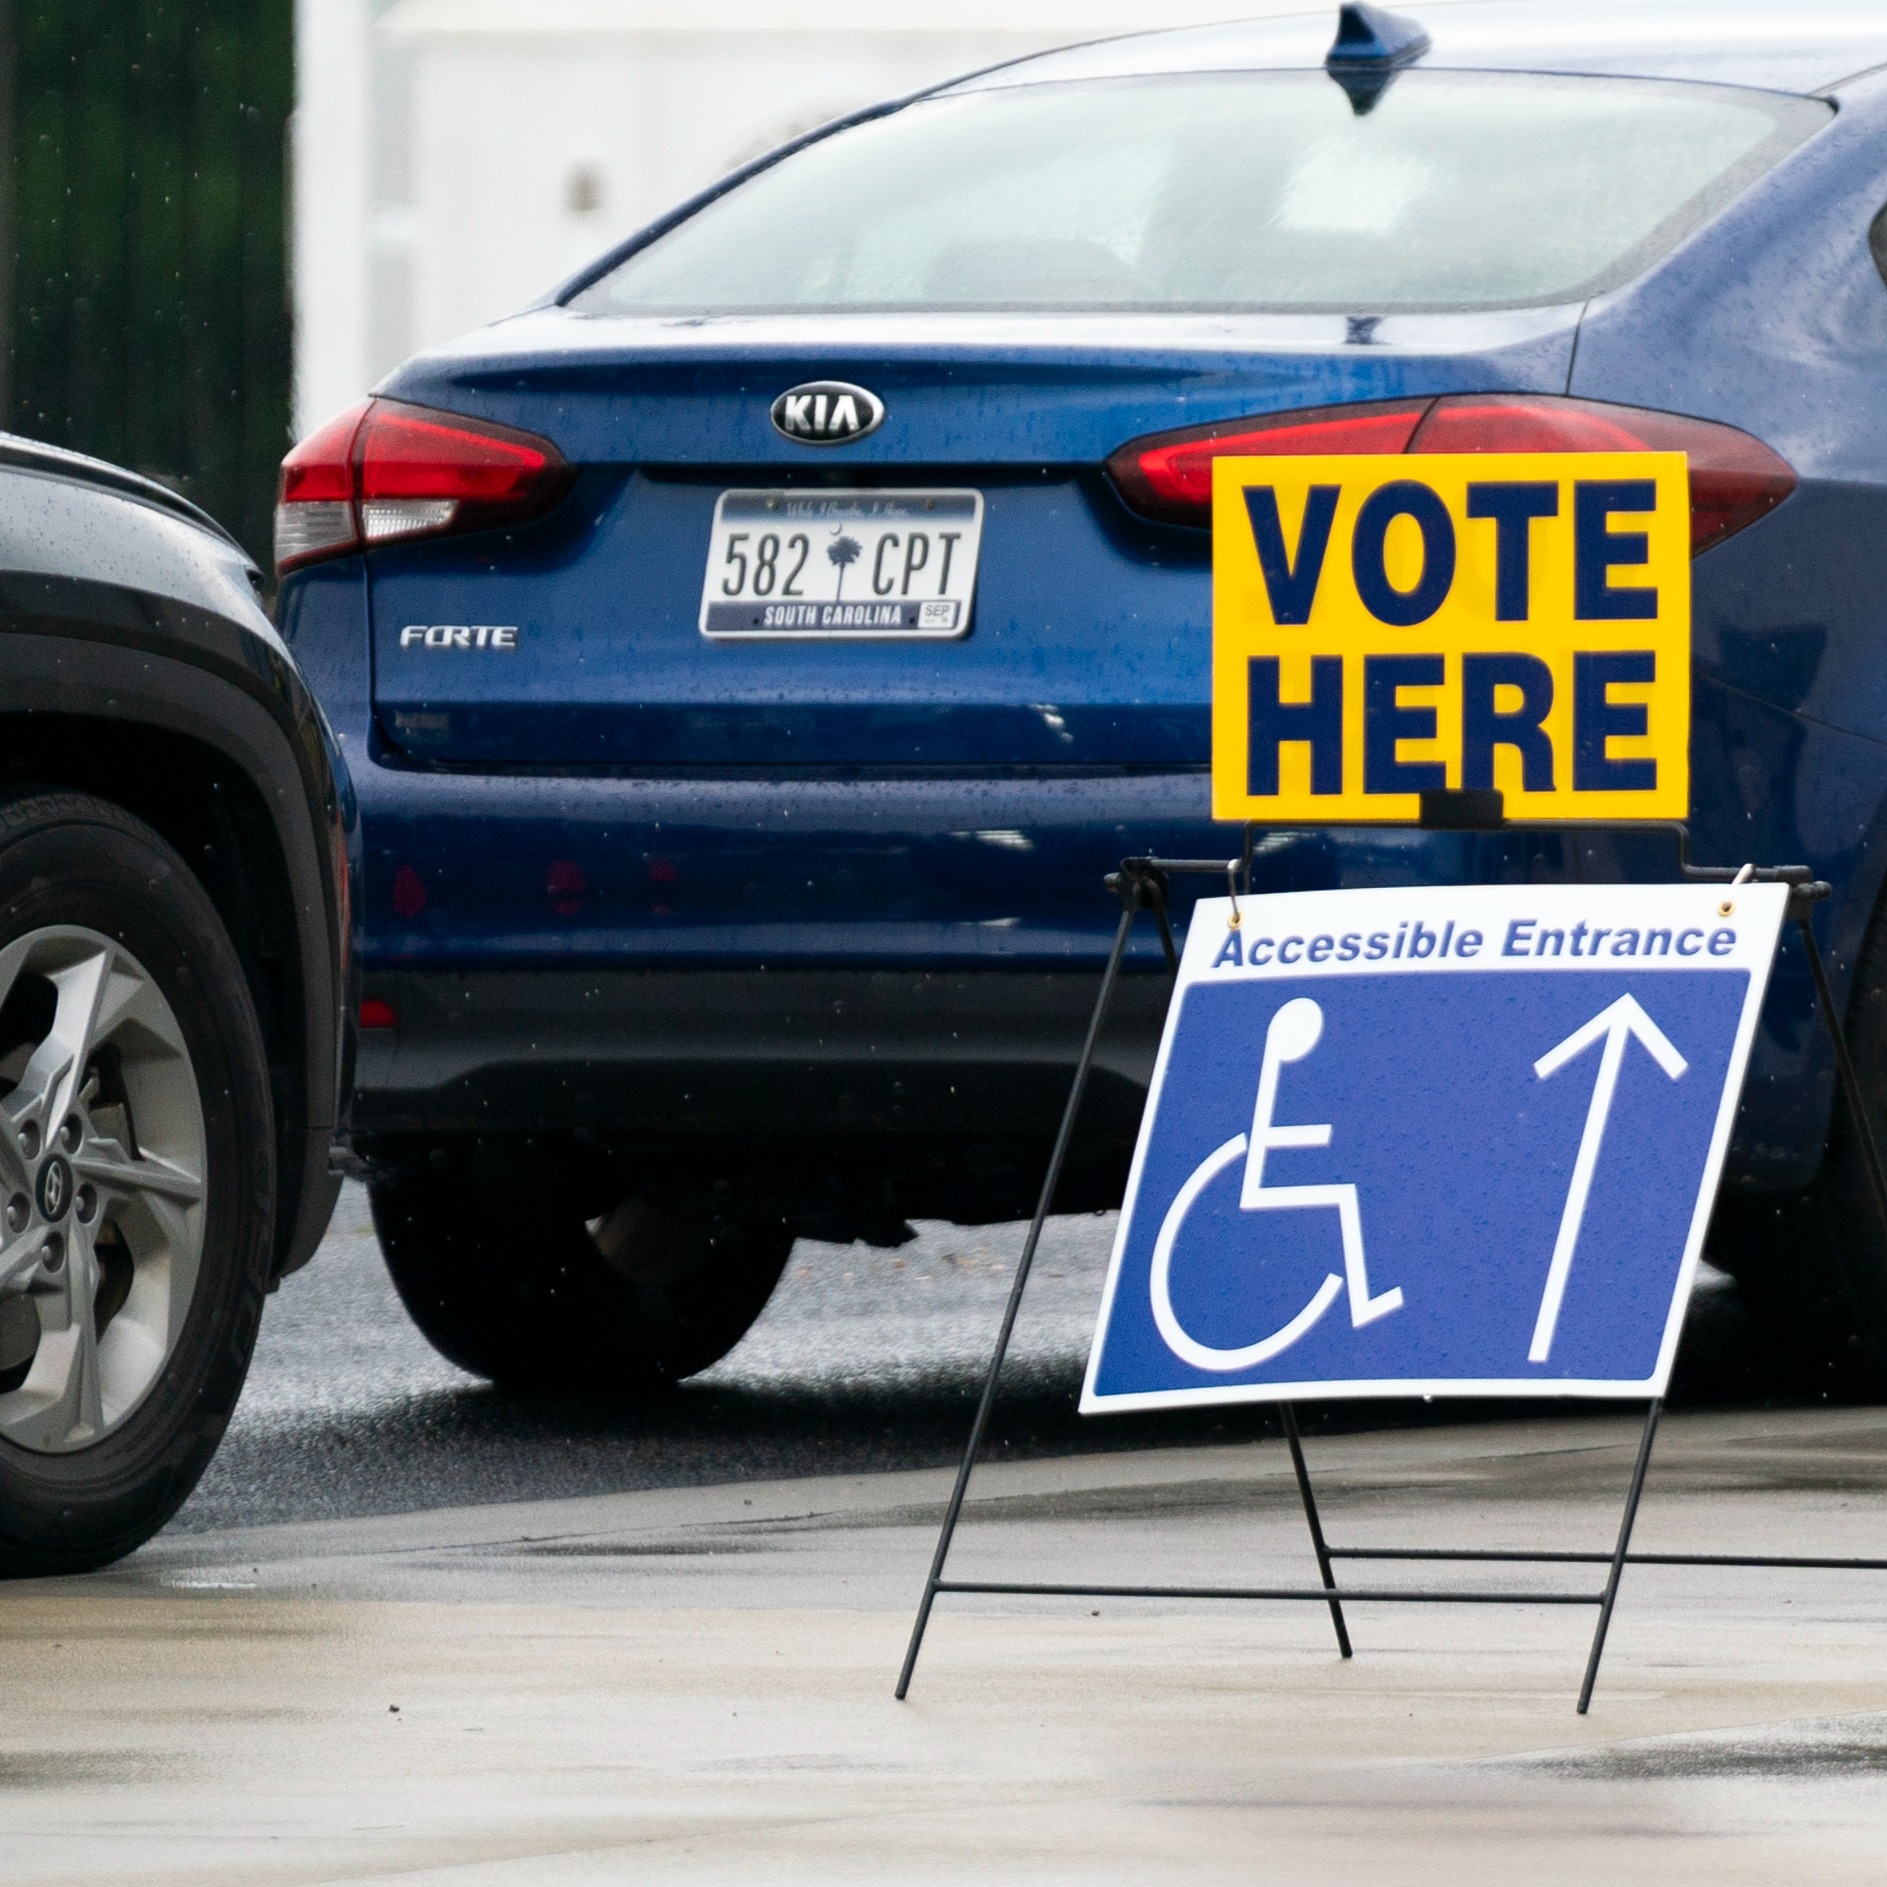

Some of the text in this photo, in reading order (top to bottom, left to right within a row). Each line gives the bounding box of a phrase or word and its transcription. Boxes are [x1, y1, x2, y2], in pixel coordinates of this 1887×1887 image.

[785, 394, 860, 431] KIA
[721, 531, 962, 596] 582 CPT
[1241, 478, 1658, 627] VOTE
[763, 605, 903, 626] SOUTH CAROLINA
[924, 604, 951, 617] SEP
[400, 625, 518, 648] FORTE
[1246, 650, 1658, 797] HERE
[1210, 918, 1738, 969] Accessible Entrance
